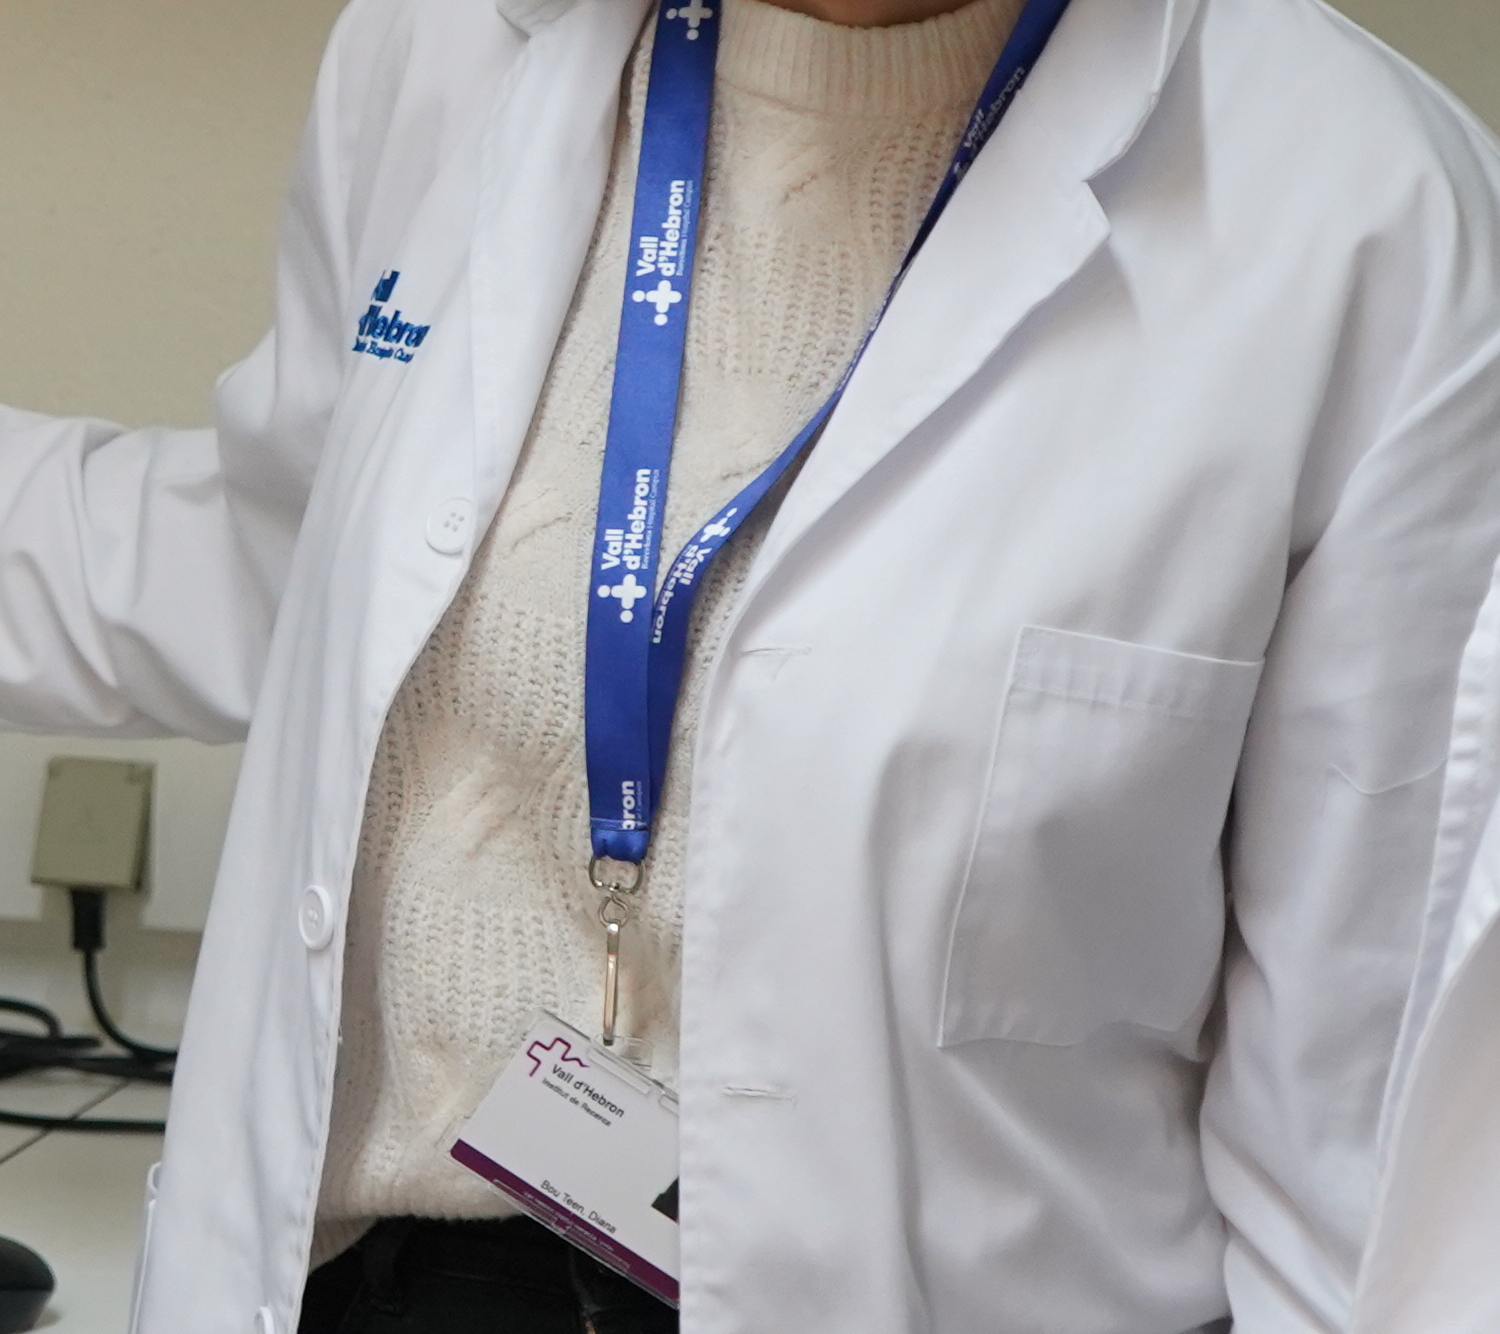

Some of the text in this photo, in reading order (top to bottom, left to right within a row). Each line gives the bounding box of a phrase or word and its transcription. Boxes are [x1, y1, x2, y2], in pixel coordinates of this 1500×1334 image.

[656, 179, 687, 278] d'Hebron
[636, 236, 659, 278] Vall
[621, 468, 652, 571] d'Hebron
[601, 528, 625, 571] Vall
[679, 547, 713, 586] Vall
[551, 1063, 625, 1118] Vall d'Hebron
[540, 1178, 561, 1200] Bou
[588, 1210, 618, 1235] Diana
